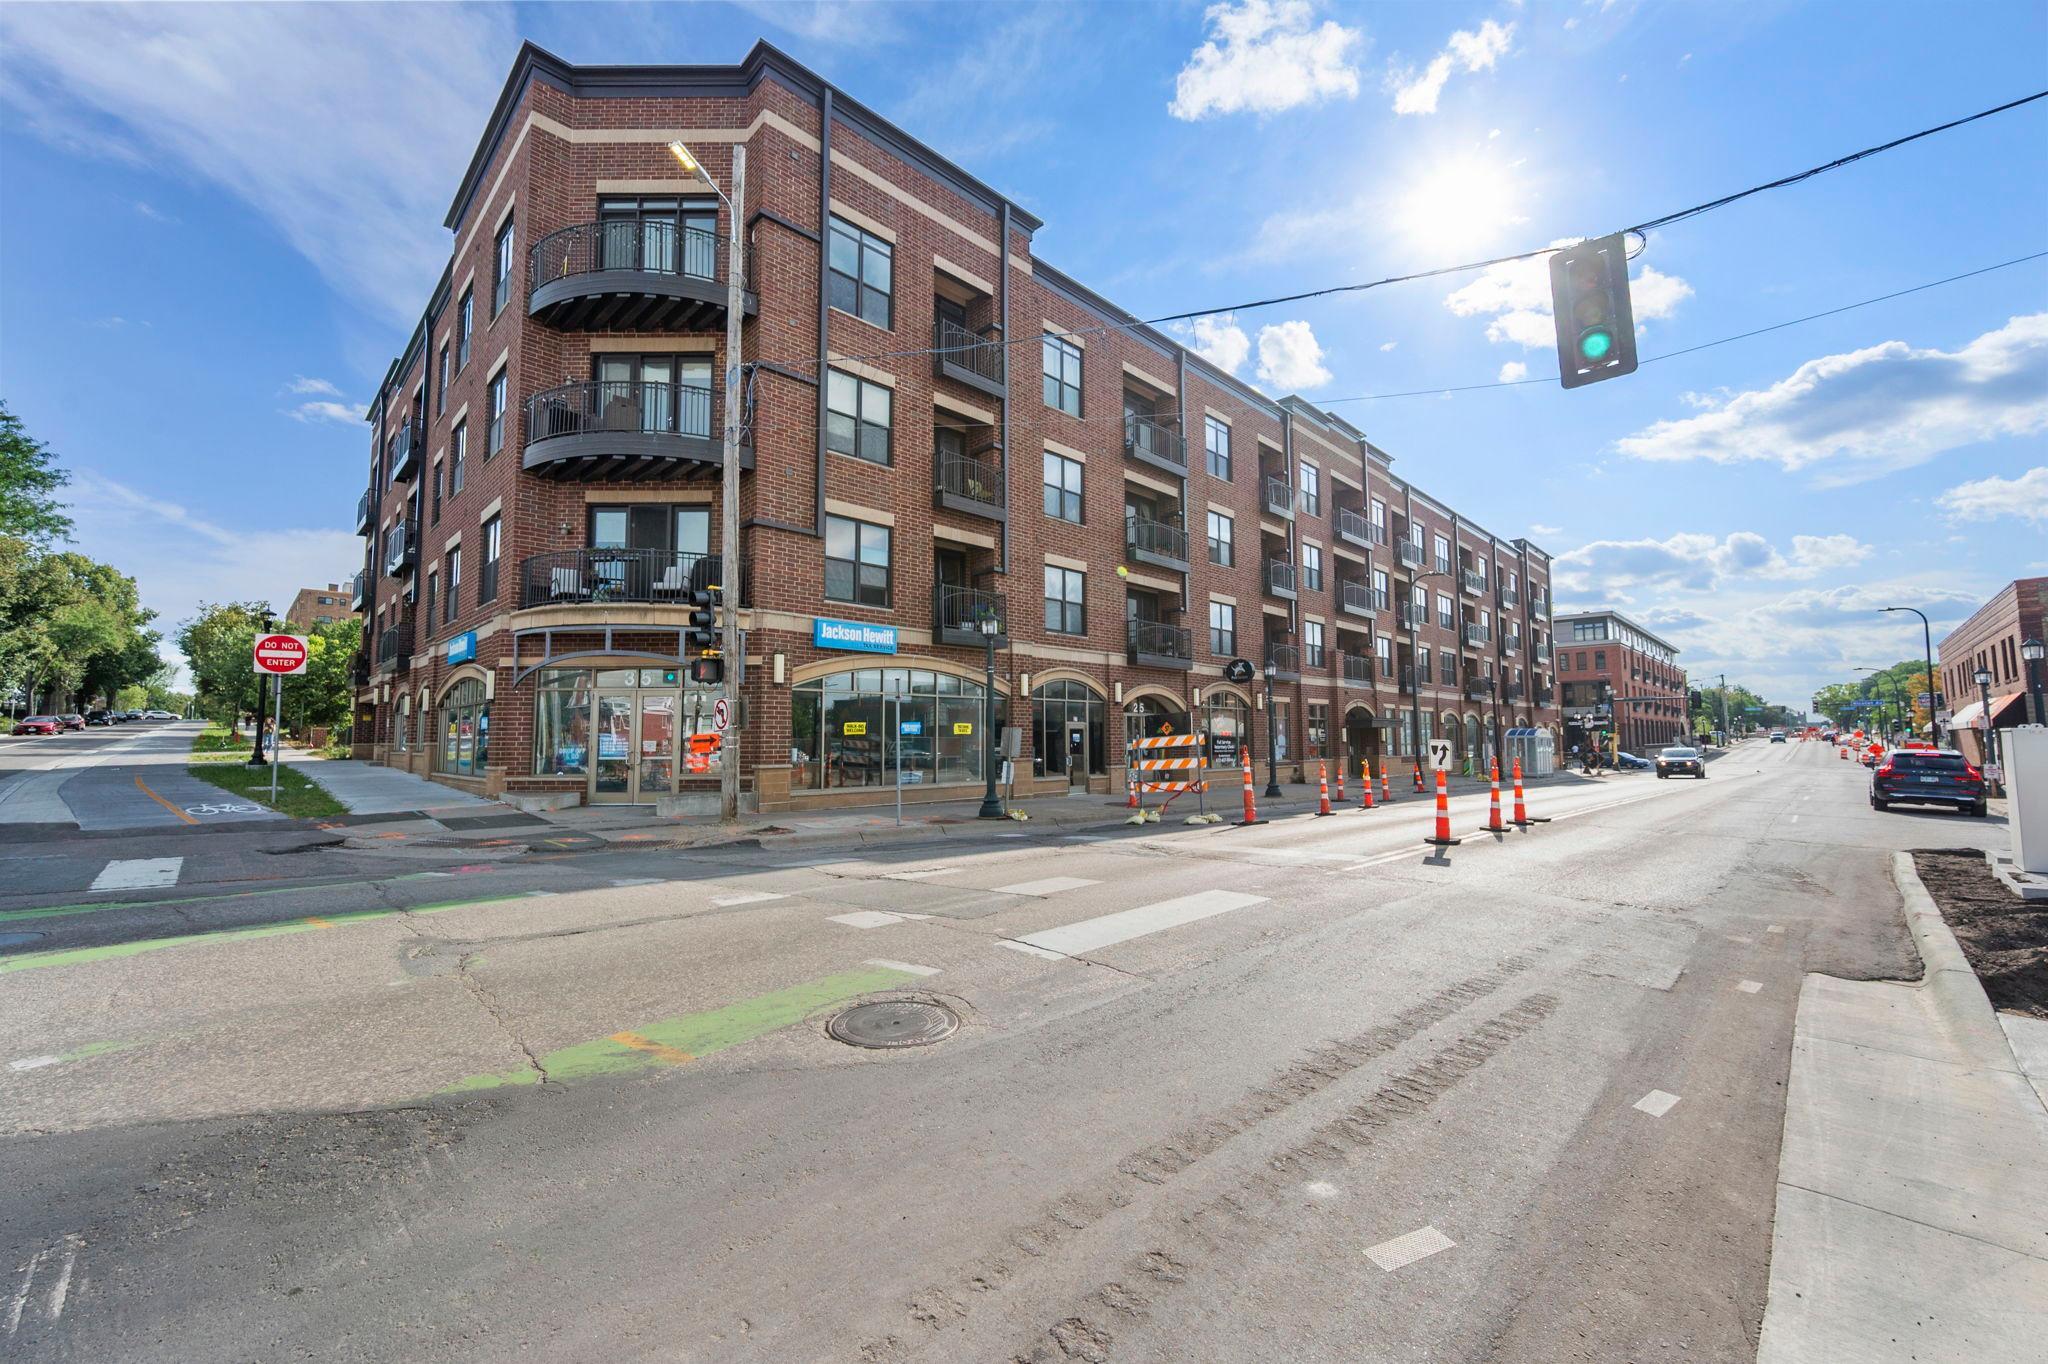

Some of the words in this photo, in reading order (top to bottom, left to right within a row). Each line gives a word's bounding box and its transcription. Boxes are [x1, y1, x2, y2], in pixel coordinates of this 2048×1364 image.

[821, 622, 862, 641] Jackson
[863, 627, 894, 645] Hewitt
[264, 641, 277, 649] DO
[281, 642, 299, 650] NOT
[266, 659, 296, 667] ENTER
